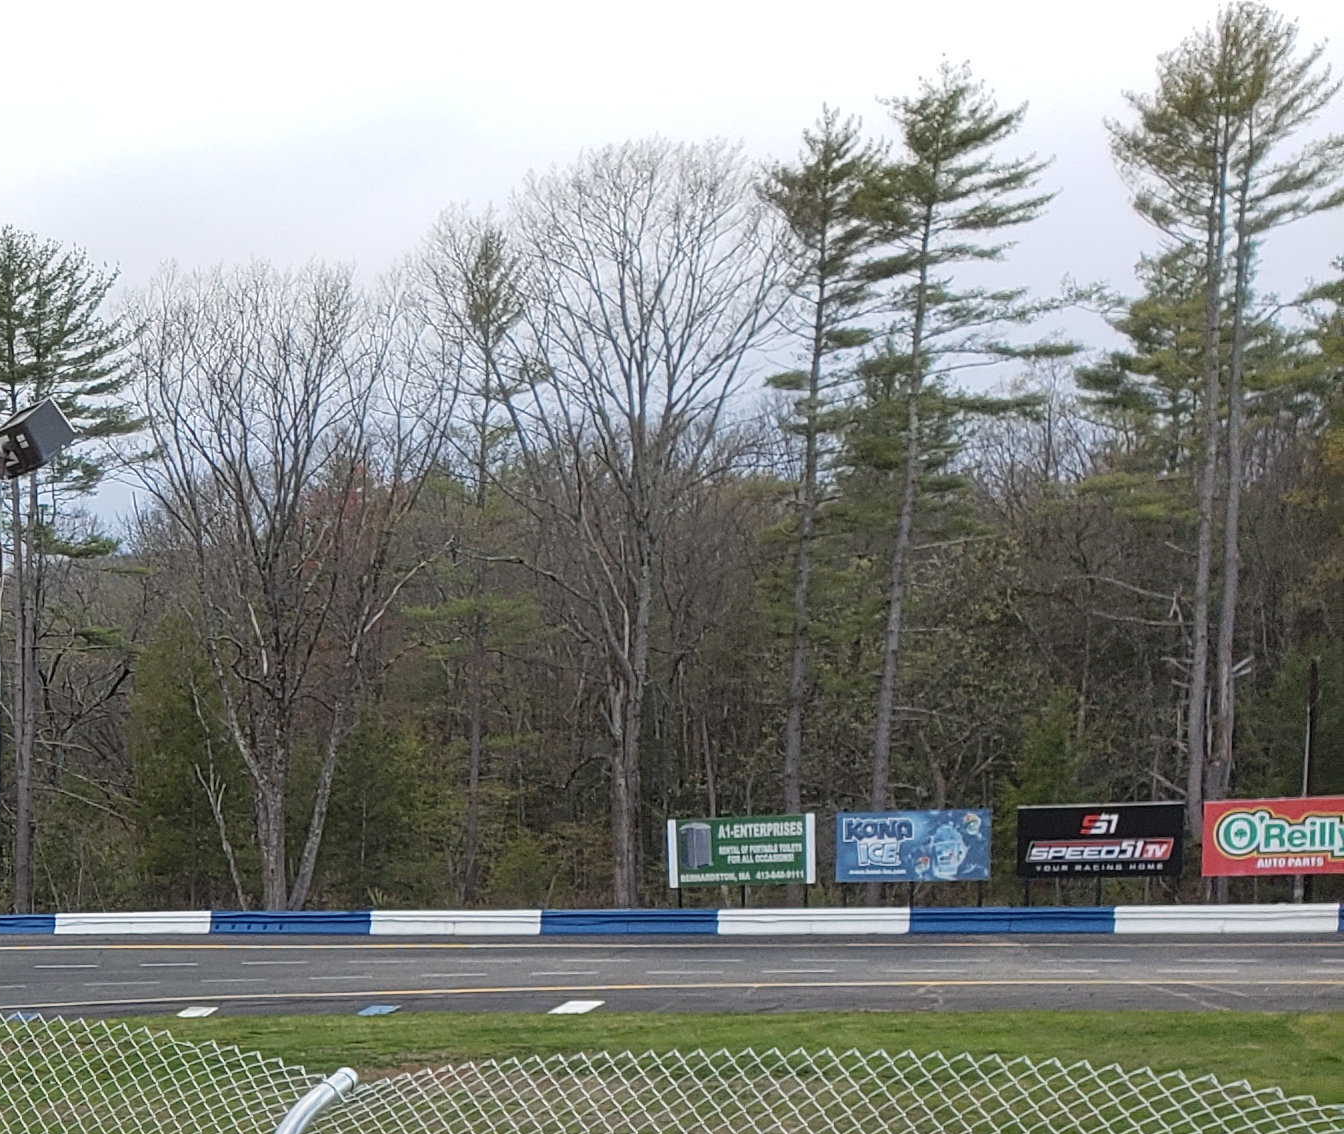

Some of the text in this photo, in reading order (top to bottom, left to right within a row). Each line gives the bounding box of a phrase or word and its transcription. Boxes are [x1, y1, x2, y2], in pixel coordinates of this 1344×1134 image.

[718, 821, 803, 839] A1-ENTERPRISES
[844, 818, 914, 841] KONA
[741, 845, 748, 854] OF
[858, 843, 900, 865] ICE
[728, 855, 741, 864] FOR
[742, 855, 754, 863] ALL
[1257, 857, 1324, 869] AUTO PARTS
[1035, 862, 1164, 872] YOUR RACING HOME
[739, 872, 751, 880] MA
